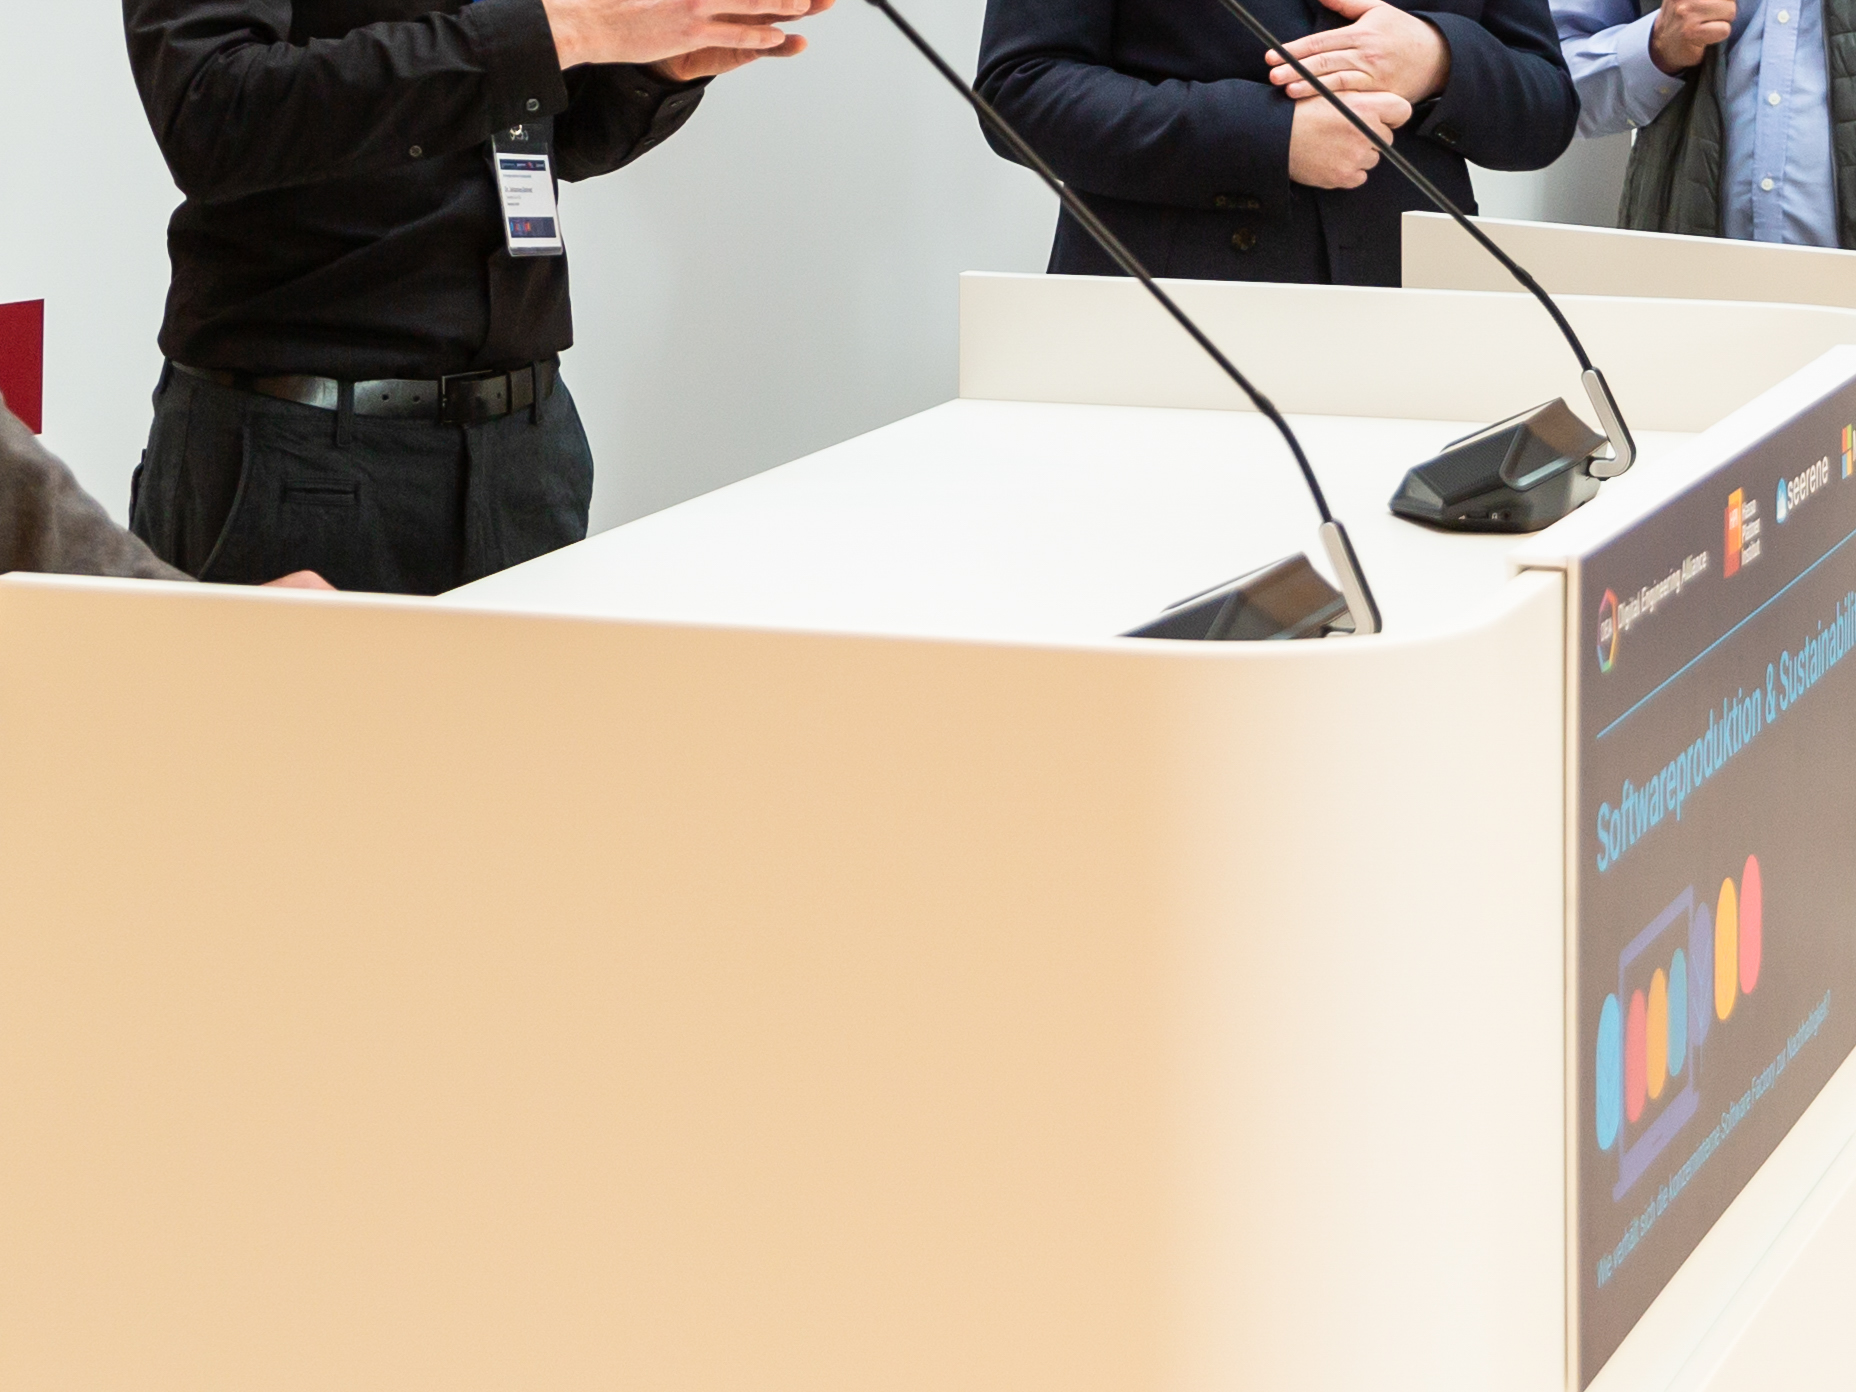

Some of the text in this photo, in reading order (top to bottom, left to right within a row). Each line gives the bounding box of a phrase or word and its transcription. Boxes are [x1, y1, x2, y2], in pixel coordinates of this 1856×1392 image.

[1787, 456, 1830, 510] seerene
[1597, 687, 1762, 872] Softwareproduktion
[1765, 663, 1777, 724] &
